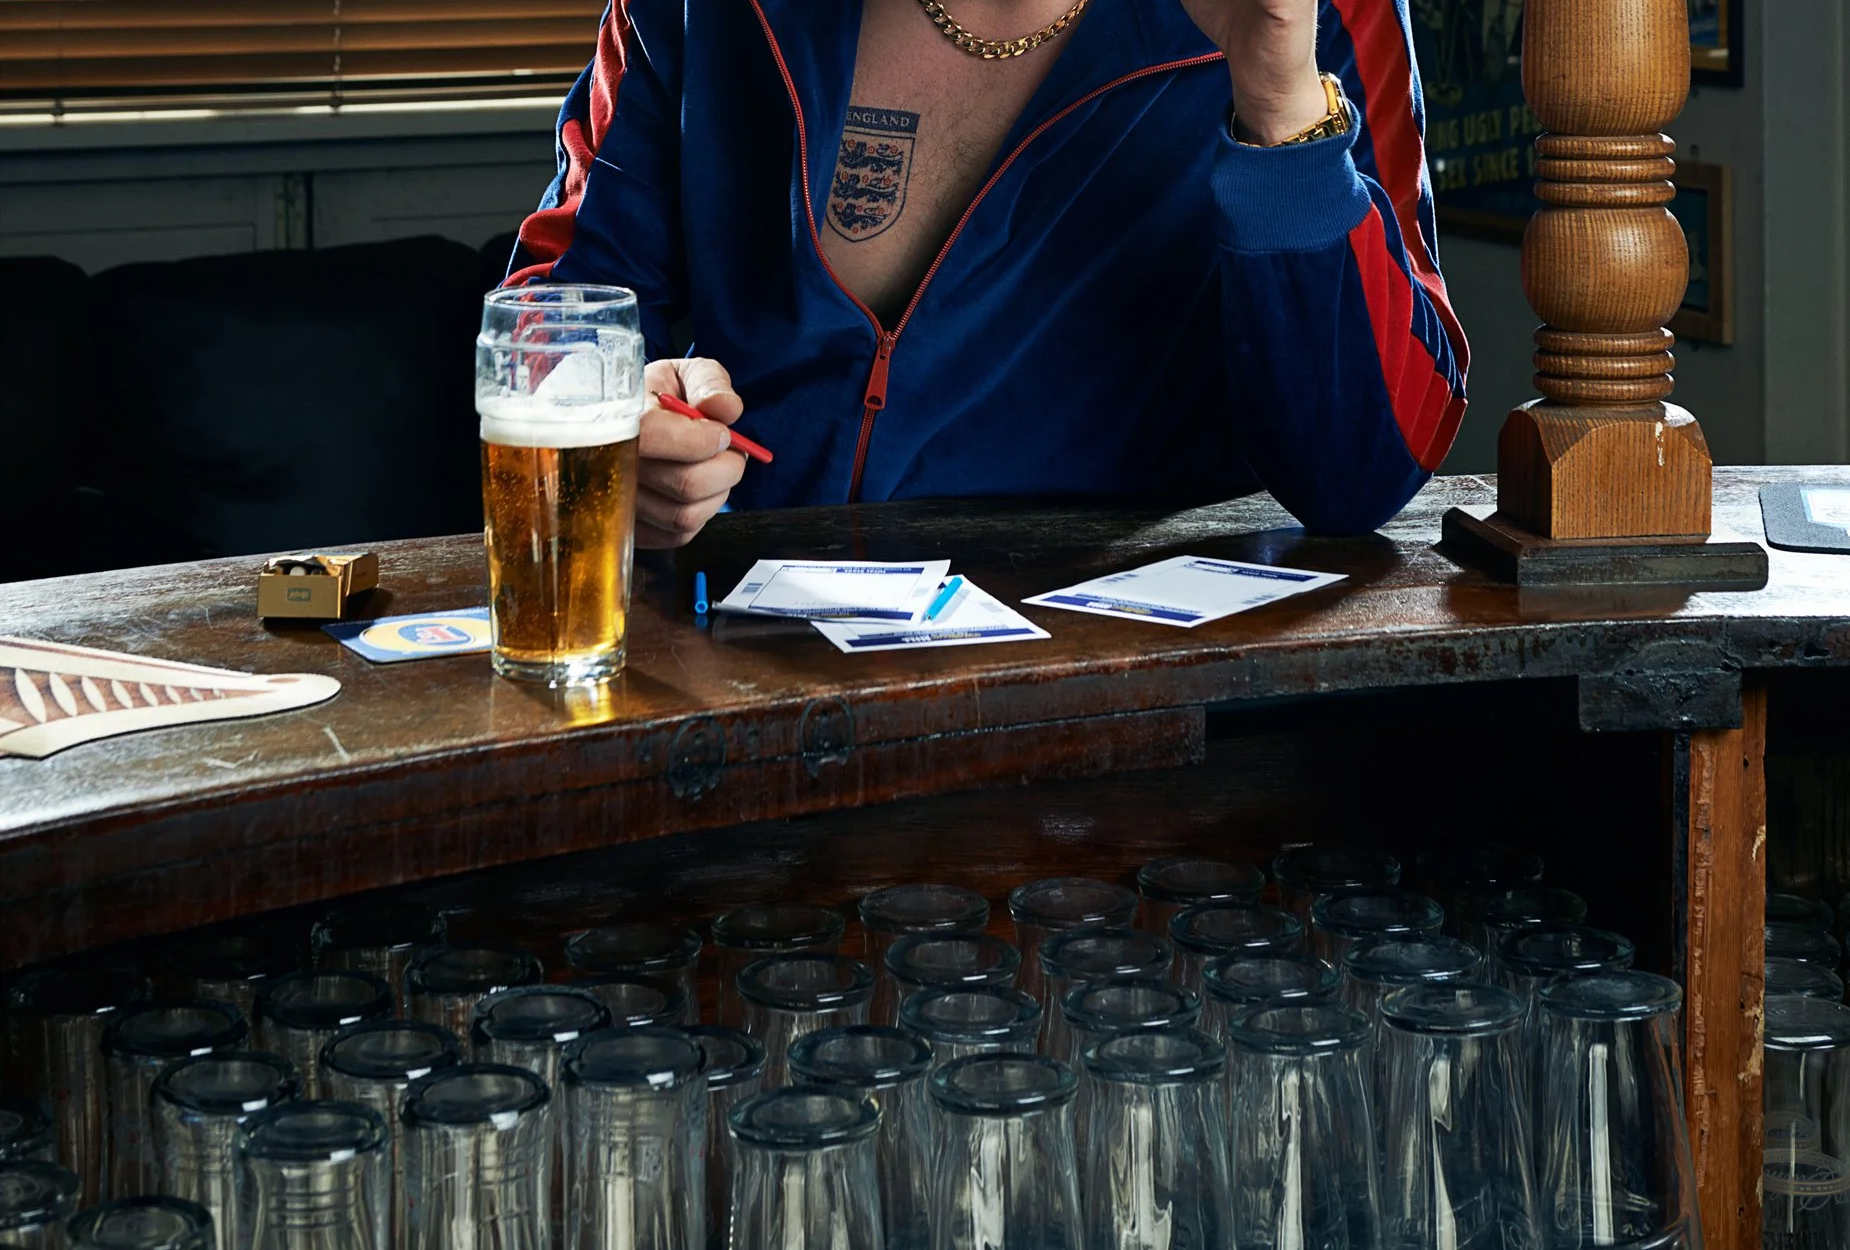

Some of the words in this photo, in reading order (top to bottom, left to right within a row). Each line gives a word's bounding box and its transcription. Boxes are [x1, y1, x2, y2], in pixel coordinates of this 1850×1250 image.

[846, 111, 910, 127] ENGLAND
[1463, 108, 1502, 147] UGLY
[1473, 146, 1519, 187] SINCE
